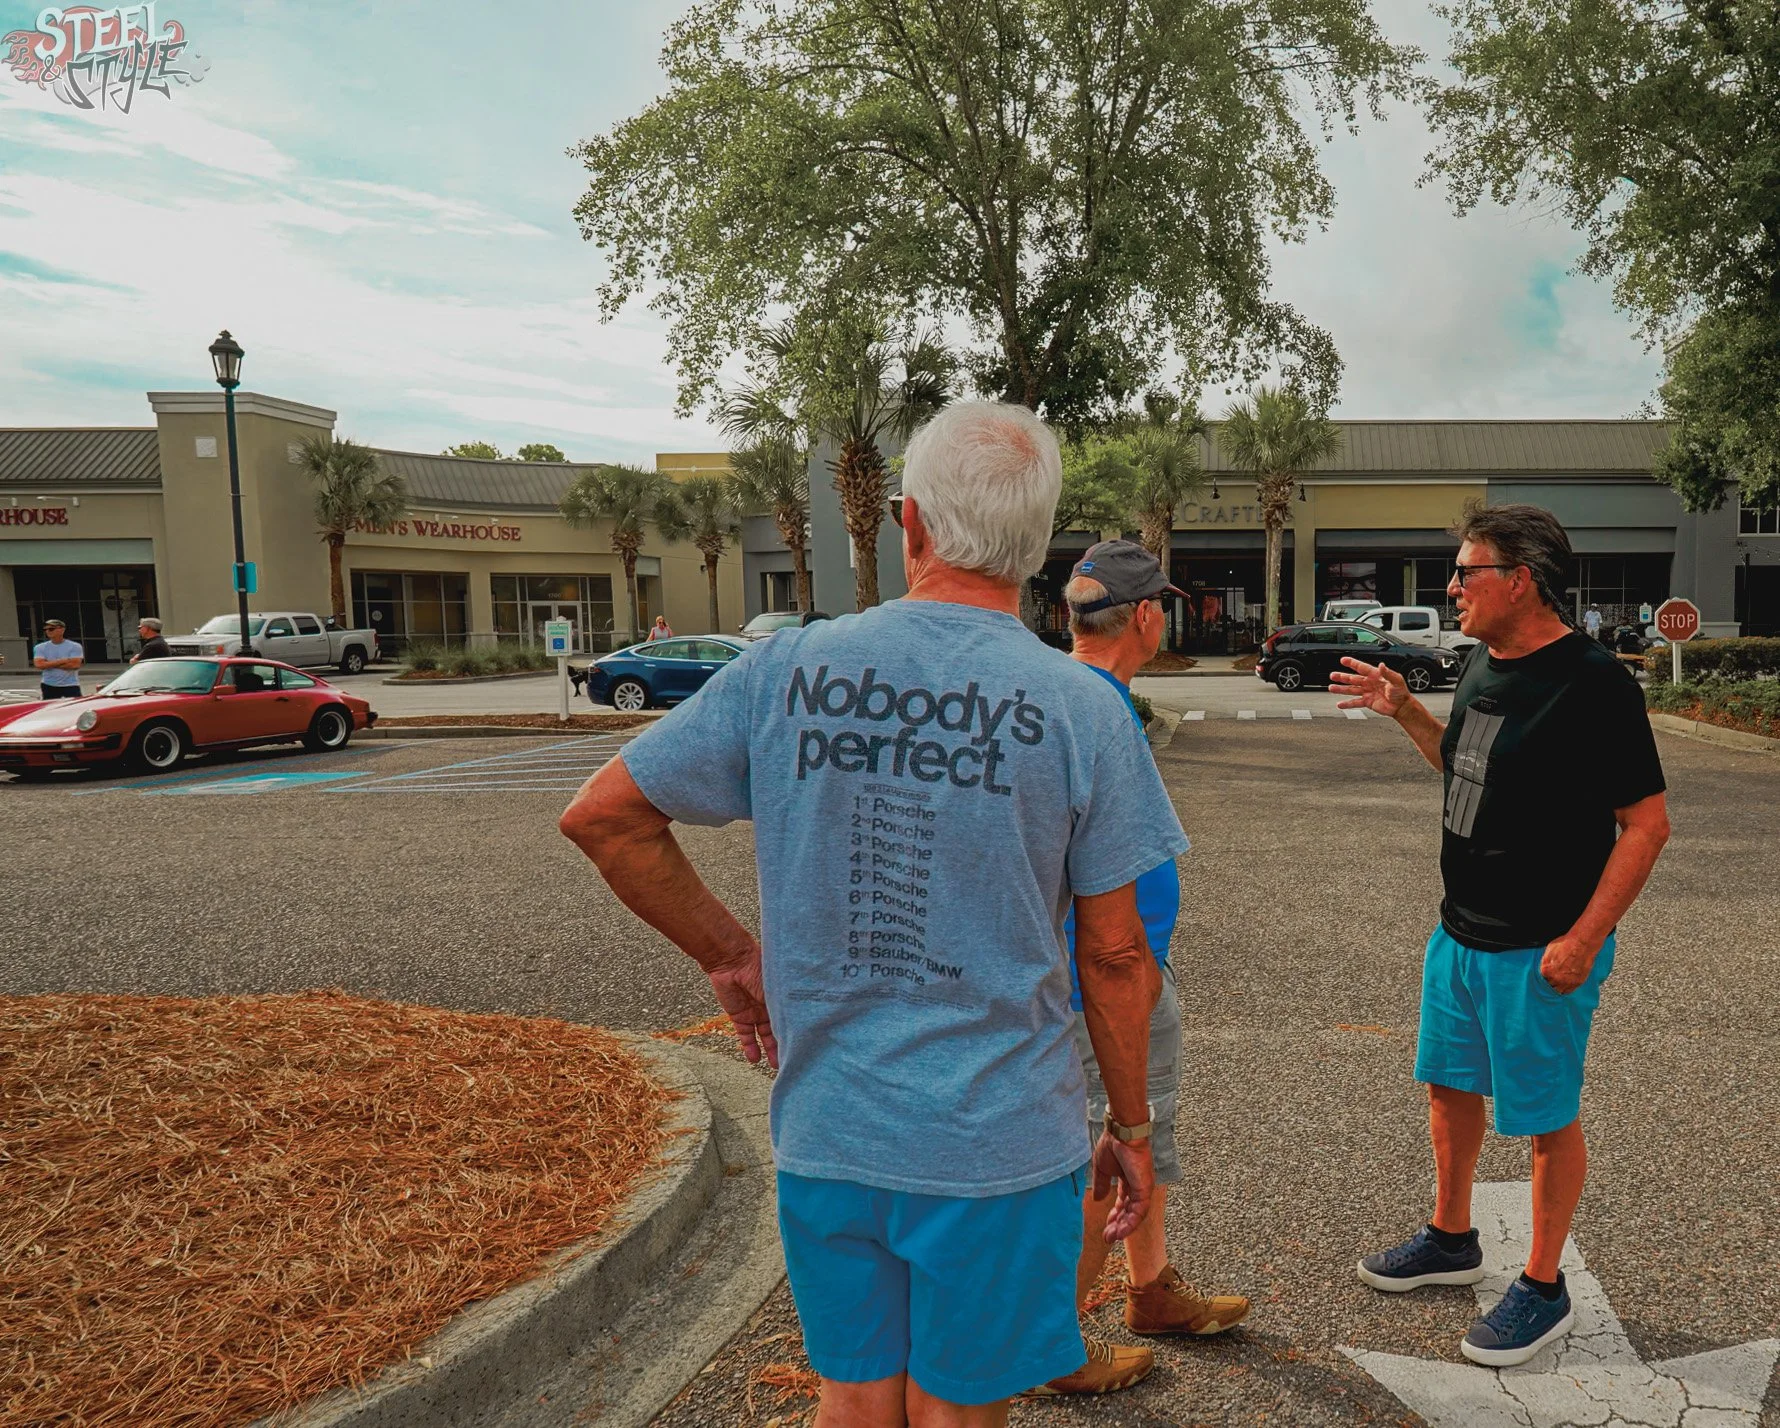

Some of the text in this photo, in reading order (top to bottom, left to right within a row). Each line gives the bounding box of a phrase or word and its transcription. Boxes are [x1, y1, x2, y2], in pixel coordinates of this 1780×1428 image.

[412, 519, 522, 542] WEARHOUSE
[1660, 613, 1696, 629] STOP
[786, 665, 1045, 746] Nobody's
[797, 727, 1012, 797] perfect.
[873, 797, 936, 822] Porsche
[872, 818, 935, 841] Porsche
[871, 836, 933, 860] Porsche
[872, 853, 931, 880] Porsche
[873, 870, 928, 899] Porsche
[872, 890, 927, 918] Porsche
[872, 910, 925, 936] Porsche
[870, 930, 926, 952] Porsche
[869, 946, 963, 979] Sauber/BMW
[870, 963, 925, 986] Porsche
